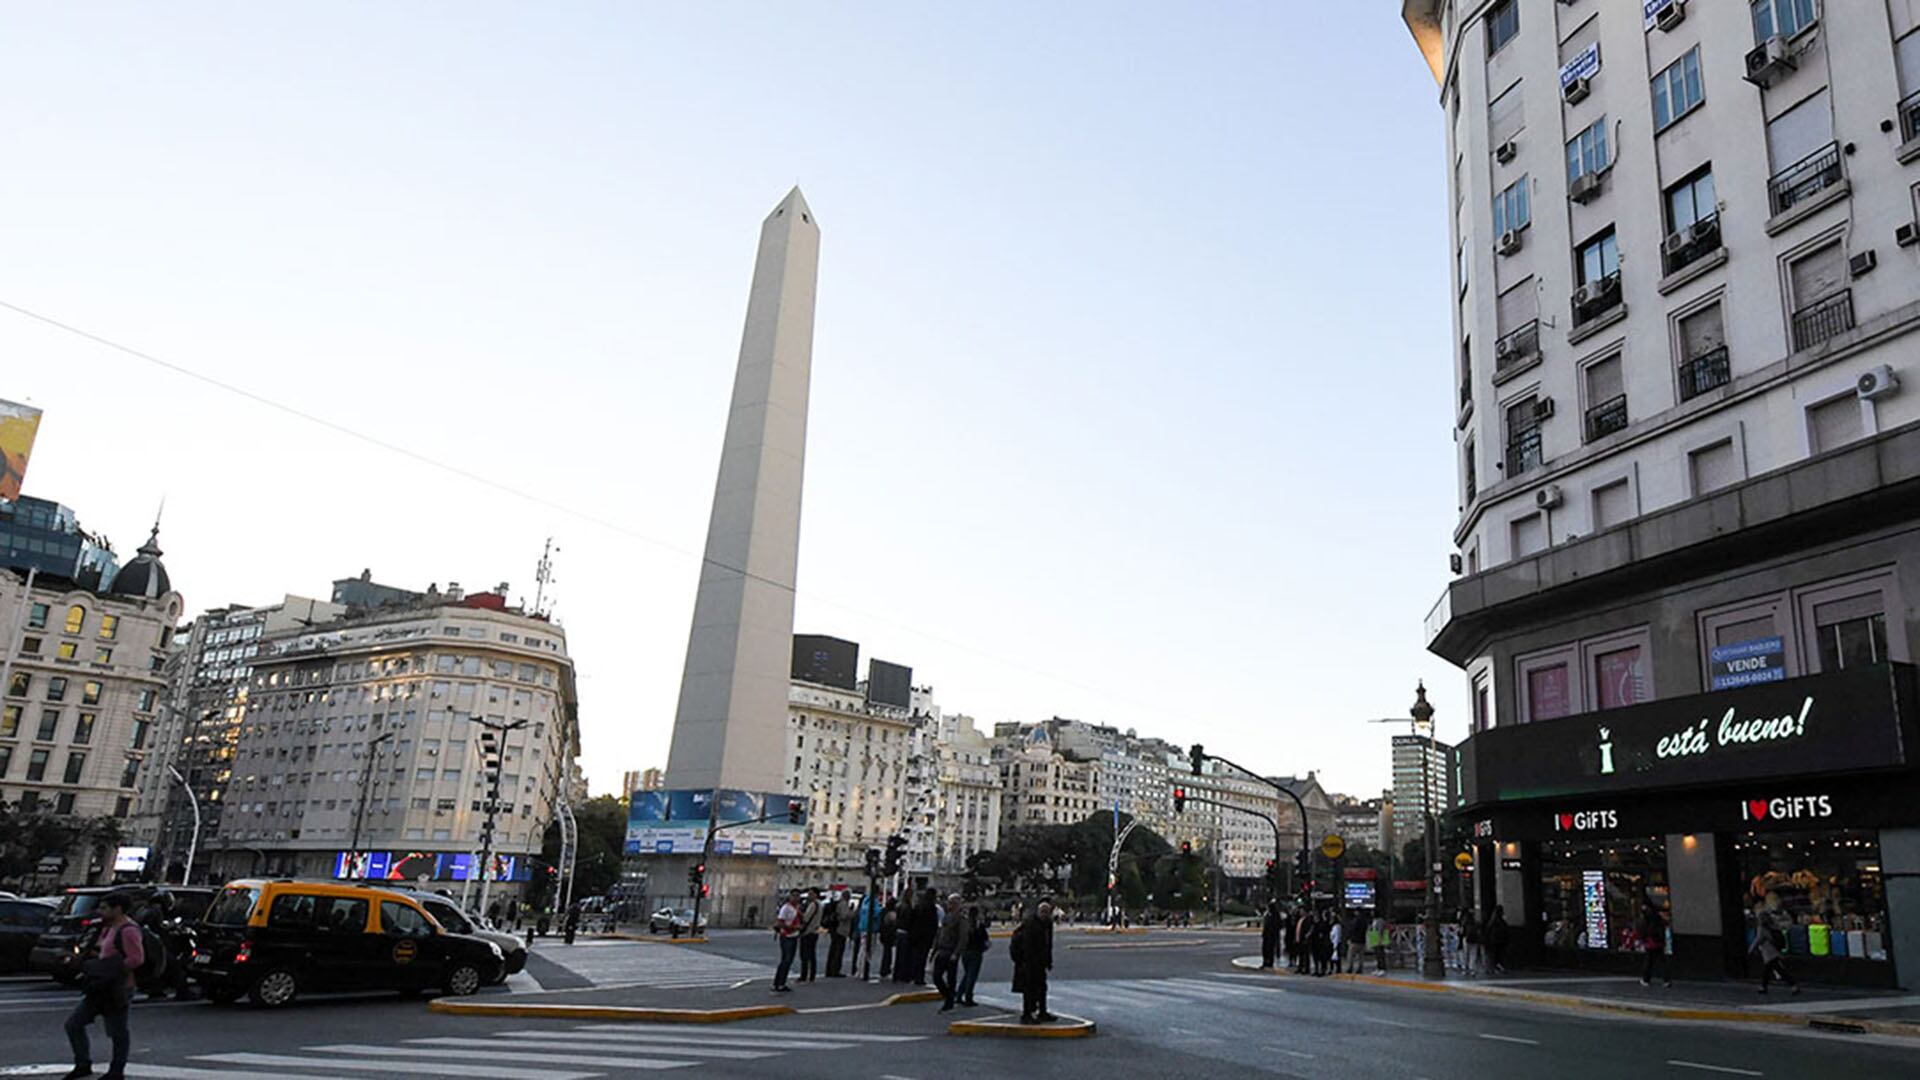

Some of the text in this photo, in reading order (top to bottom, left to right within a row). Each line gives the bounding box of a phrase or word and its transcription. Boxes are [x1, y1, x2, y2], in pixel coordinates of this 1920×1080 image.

[1726, 655, 1768, 673] VENDE
[1656, 718, 1710, 758] está
[1717, 696, 1814, 746] bueno!
